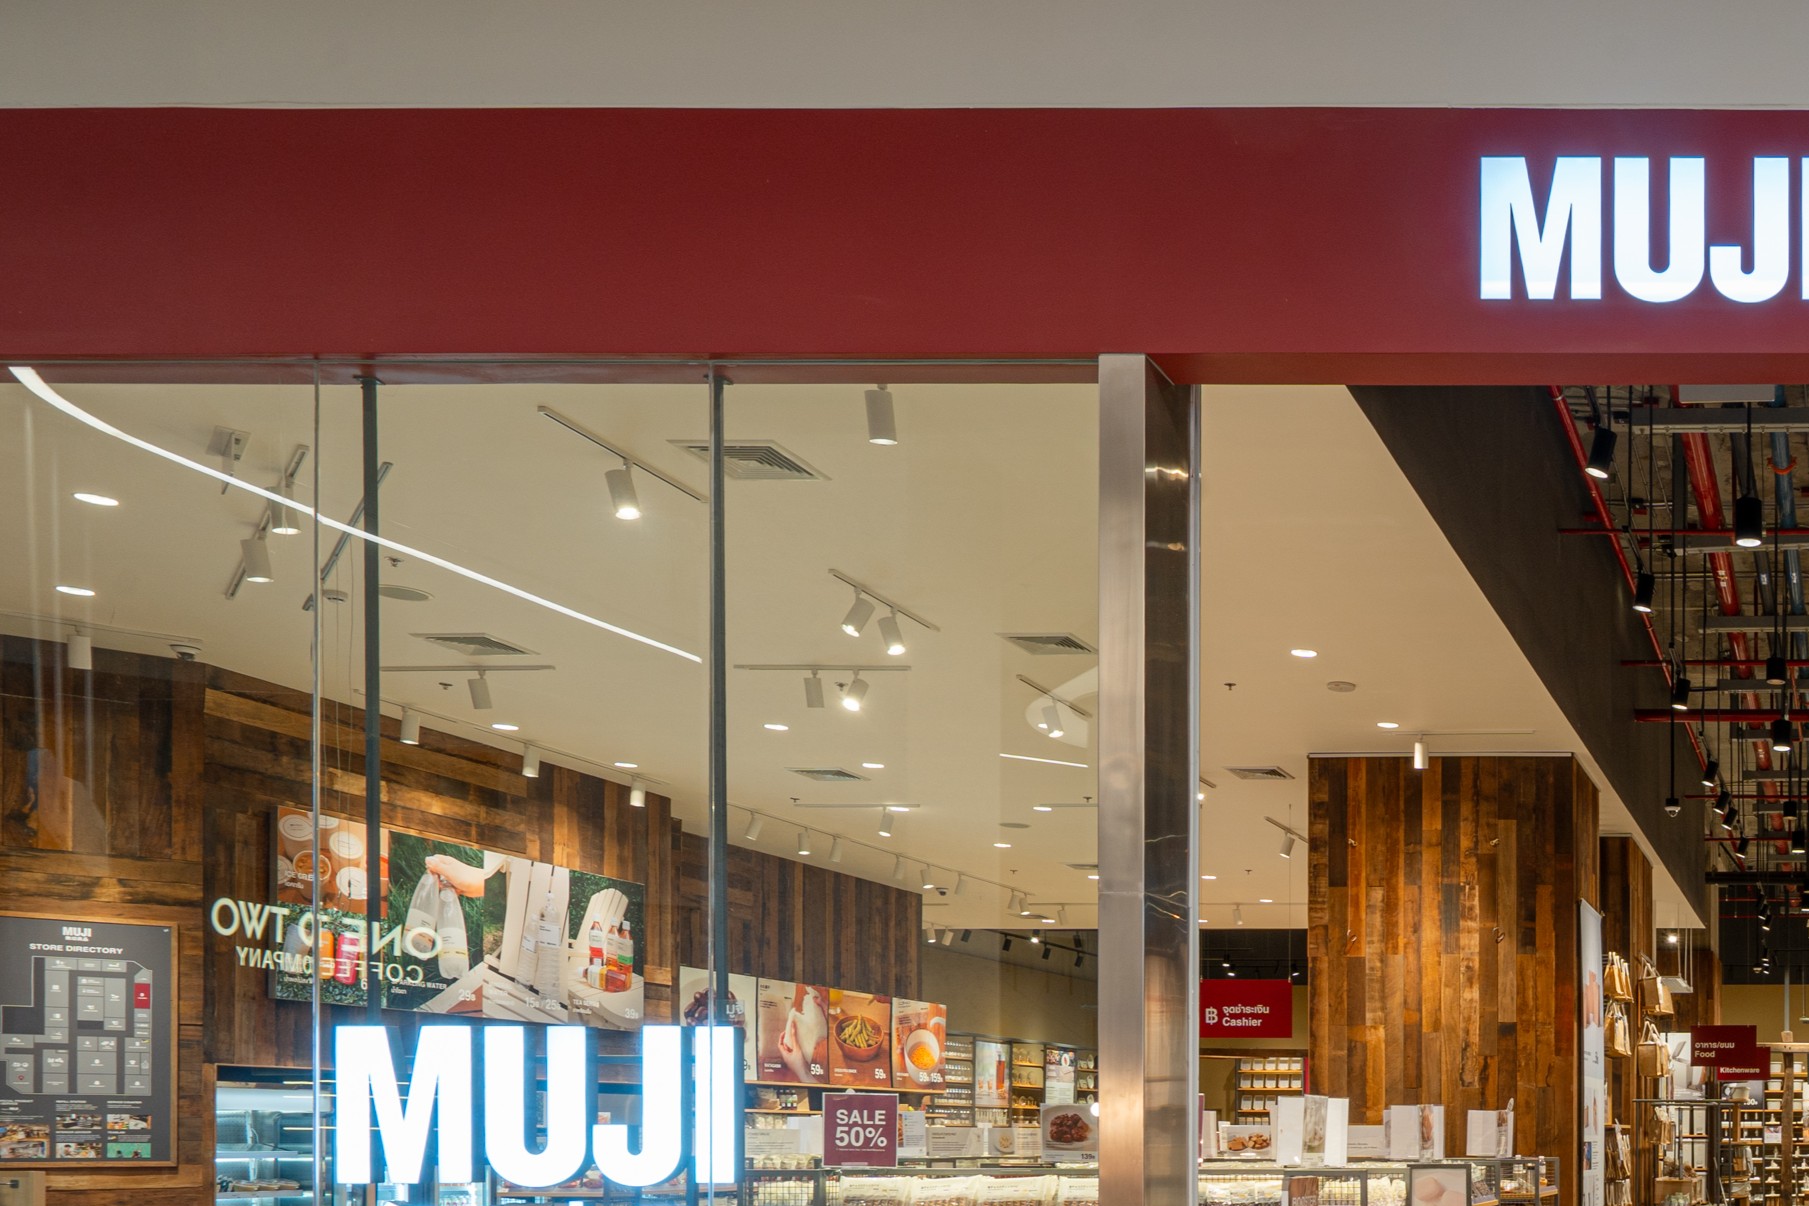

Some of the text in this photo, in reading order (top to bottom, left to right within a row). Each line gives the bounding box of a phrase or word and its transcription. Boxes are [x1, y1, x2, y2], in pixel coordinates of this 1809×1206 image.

[62, 927, 92, 937] MUJI
[29, 943, 123, 954] STORE DIRECTORY
[1222, 1003, 1270, 1016] จุดชำระเงิน
[1222, 1017, 1262, 1027] Cashier
[1694, 1050, 1716, 1058] Food
[1719, 1066, 1761, 1074] Kitchenware
[335, 1025, 738, 1187] MUJI
[836, 1109, 886, 1125] SALE
[835, 1127, 887, 1147] 50%
